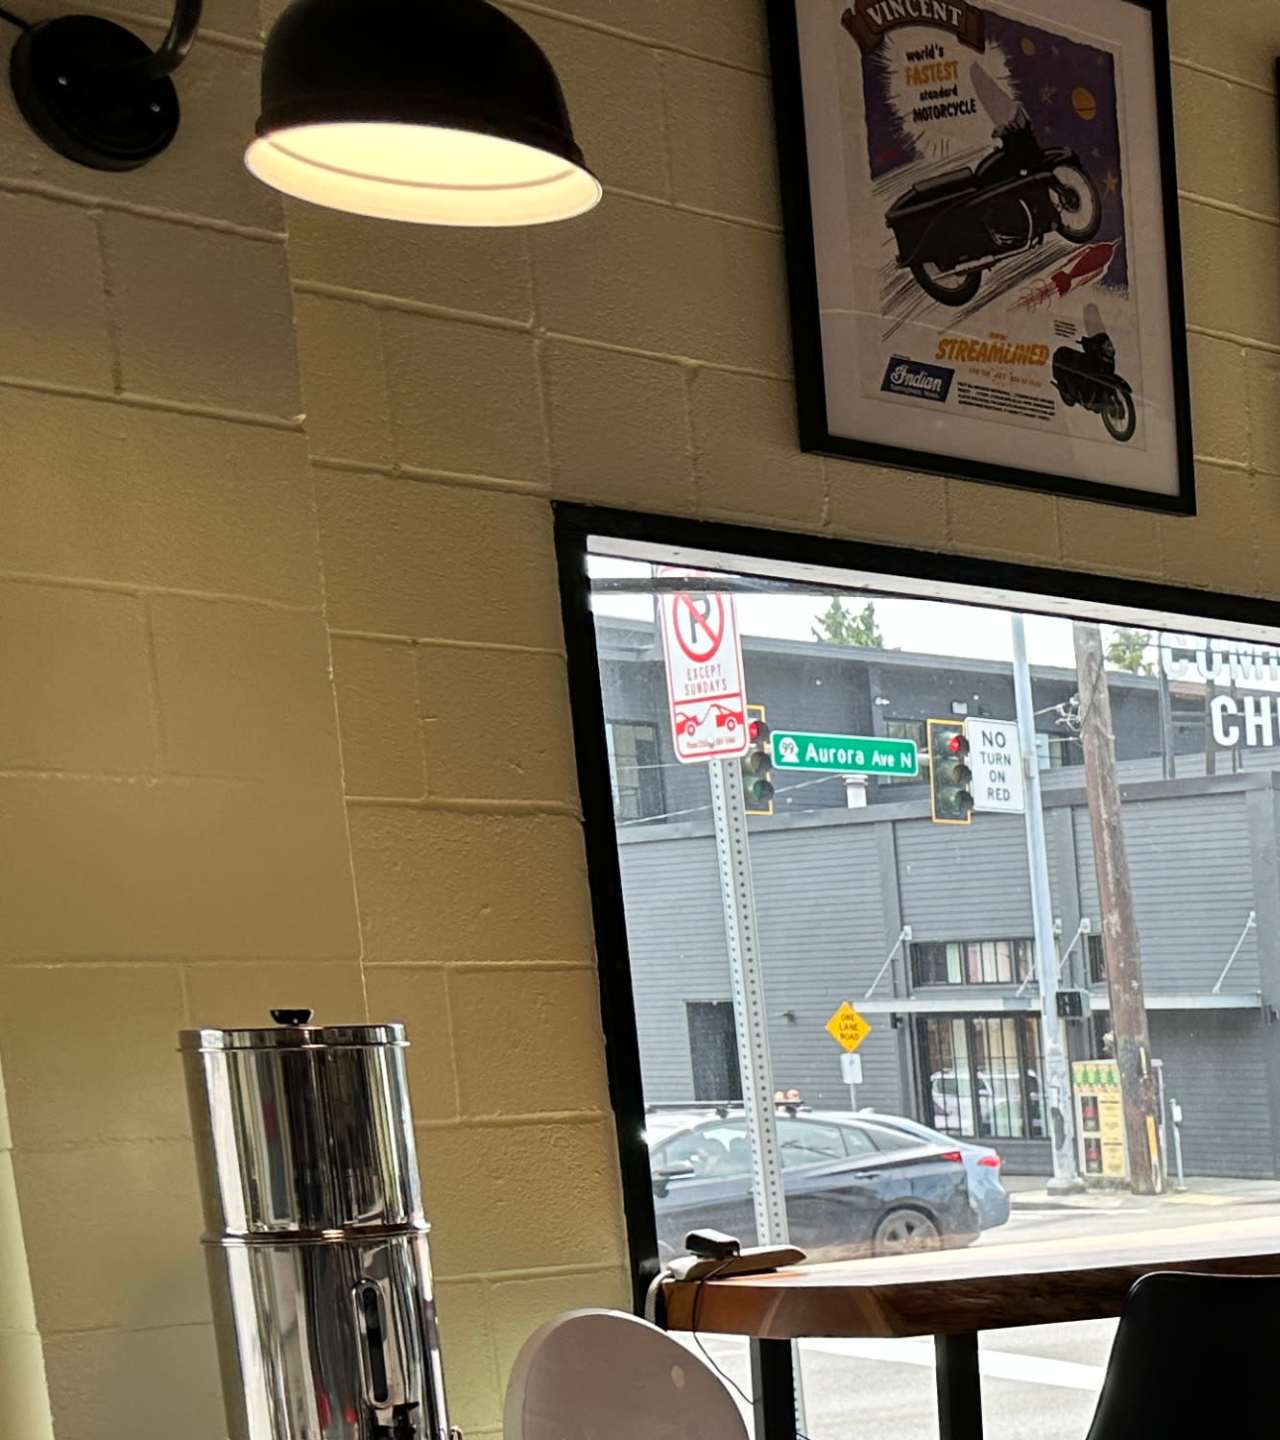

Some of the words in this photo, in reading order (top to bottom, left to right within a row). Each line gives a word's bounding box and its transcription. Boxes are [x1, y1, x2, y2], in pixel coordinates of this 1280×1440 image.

[865, 0, 963, 26] VINCENT
[905, 42, 945, 62] world's
[905, 60, 959, 87] FASTEST
[912, 98, 977, 122] MOTORCYCLE
[934, 338, 1050, 367] STREAMLINED
[890, 363, 943, 393] Indian
[686, 664, 722, 682] EXCEPT
[684, 678, 728, 697] SUNDAYS
[982, 731, 1006, 748] NO
[805, 743, 864, 766] Aurora
[872, 751, 895, 767] Ave
[900, 753, 912, 769] N
[980, 752, 1011, 766] TURN
[989, 770, 1006, 783] ON
[988, 787, 1010, 801] RED
